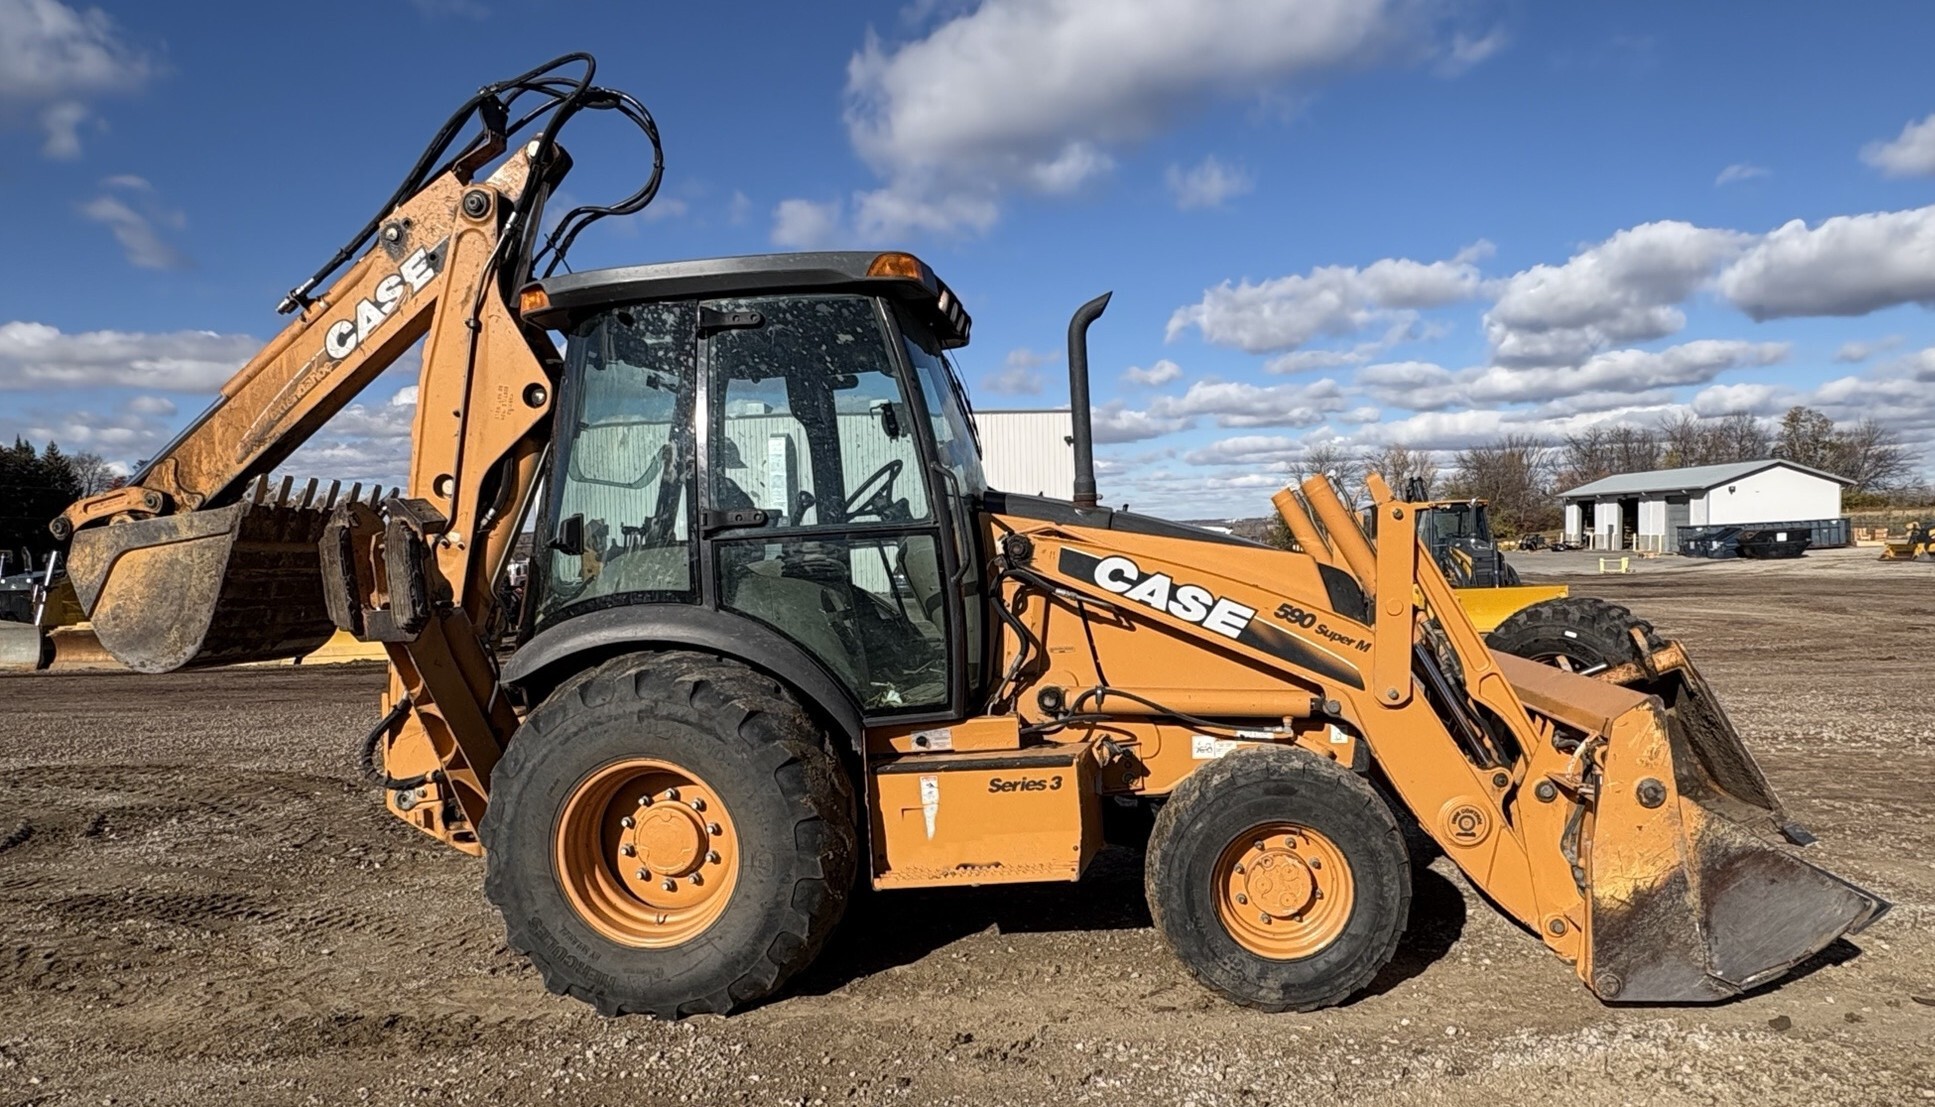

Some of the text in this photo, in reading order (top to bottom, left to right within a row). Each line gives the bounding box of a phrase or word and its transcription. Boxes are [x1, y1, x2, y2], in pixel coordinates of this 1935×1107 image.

[324, 247, 436, 360] CASE
[1093, 555, 1257, 639] CASE
[1274, 603, 1372, 653] 590 Super M
[988, 775, 1063, 793] Series 3
[528, 916, 617, 991] HERCULES
